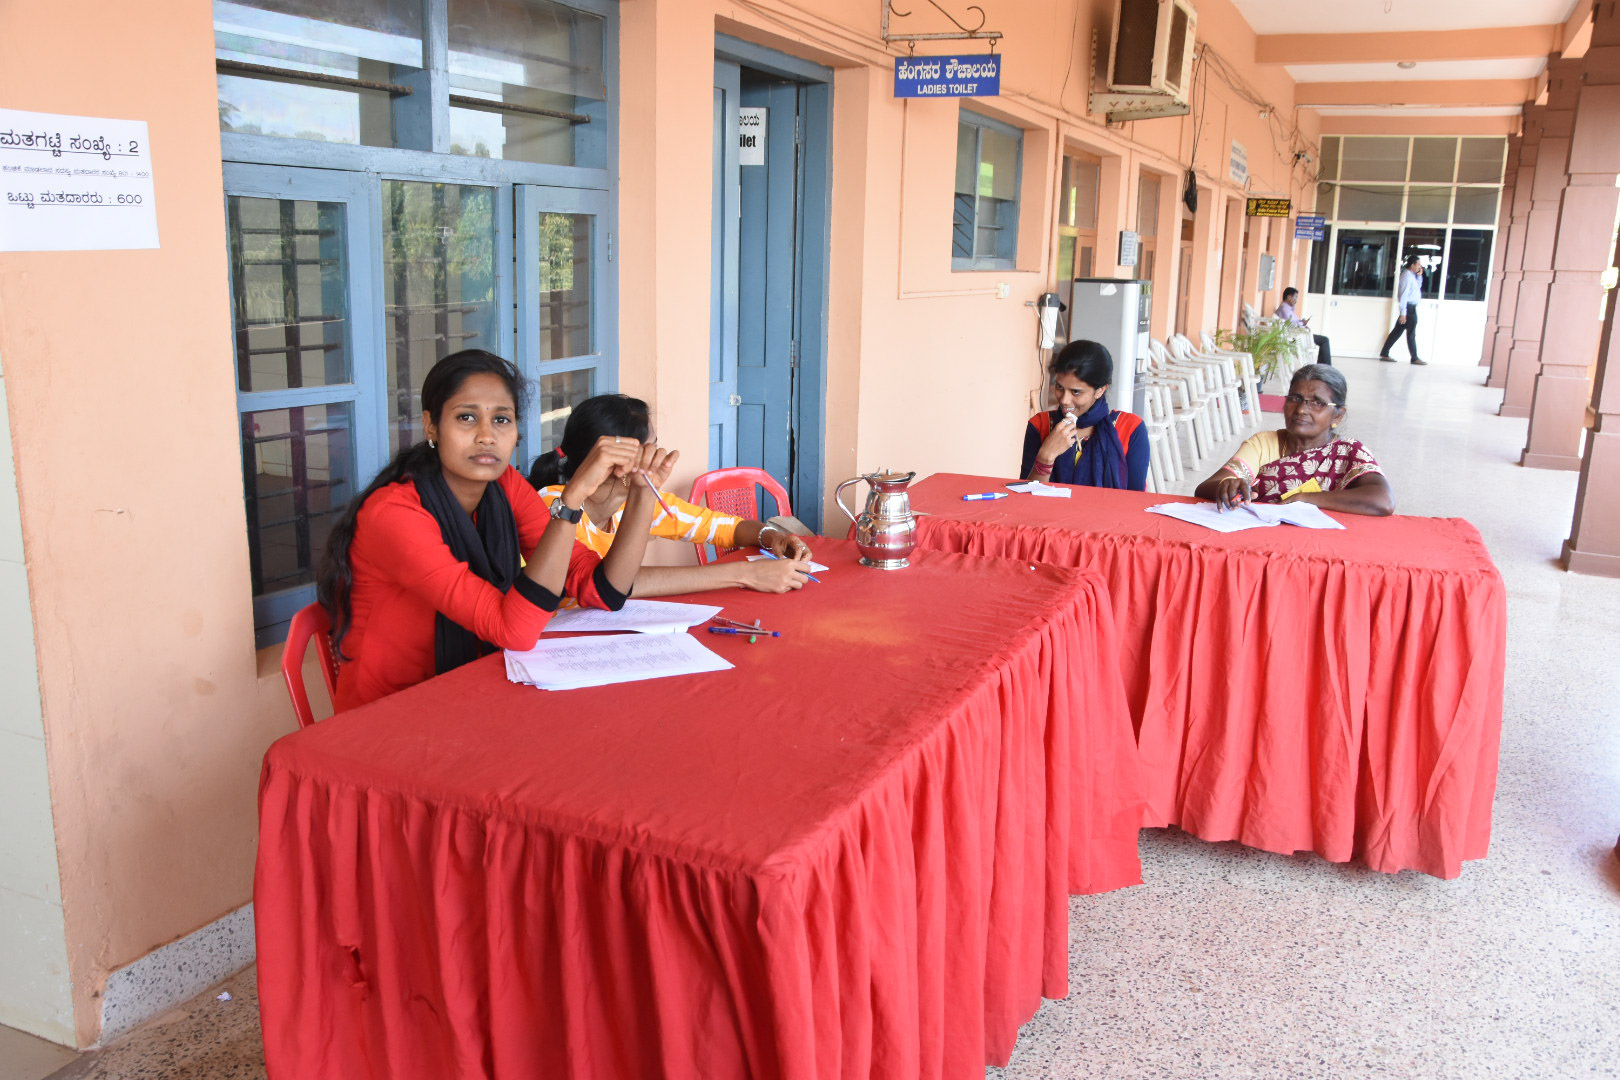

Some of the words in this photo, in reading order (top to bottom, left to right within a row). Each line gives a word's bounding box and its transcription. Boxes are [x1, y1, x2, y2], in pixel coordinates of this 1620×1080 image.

[898, 60, 941, 80] ಹೆಂಗಸರ
[945, 58, 997, 79] ಶೌಚಾಲಯ
[917, 84, 947, 95] LADIES
[949, 83, 978, 94] TOILET
[0, 129, 62, 157] ಮತಗಟ್ಟೆ
[70, 134, 111, 160] ಸಂಖ್ಯೆ
[129, 141, 139, 153] 2
[739, 134, 757, 148] ilet
[7, 191, 35, 209] ಒಟ್ಟು
[40, 190, 104, 204] ಮತದಾರರು
[117, 194, 143, 204] 600
